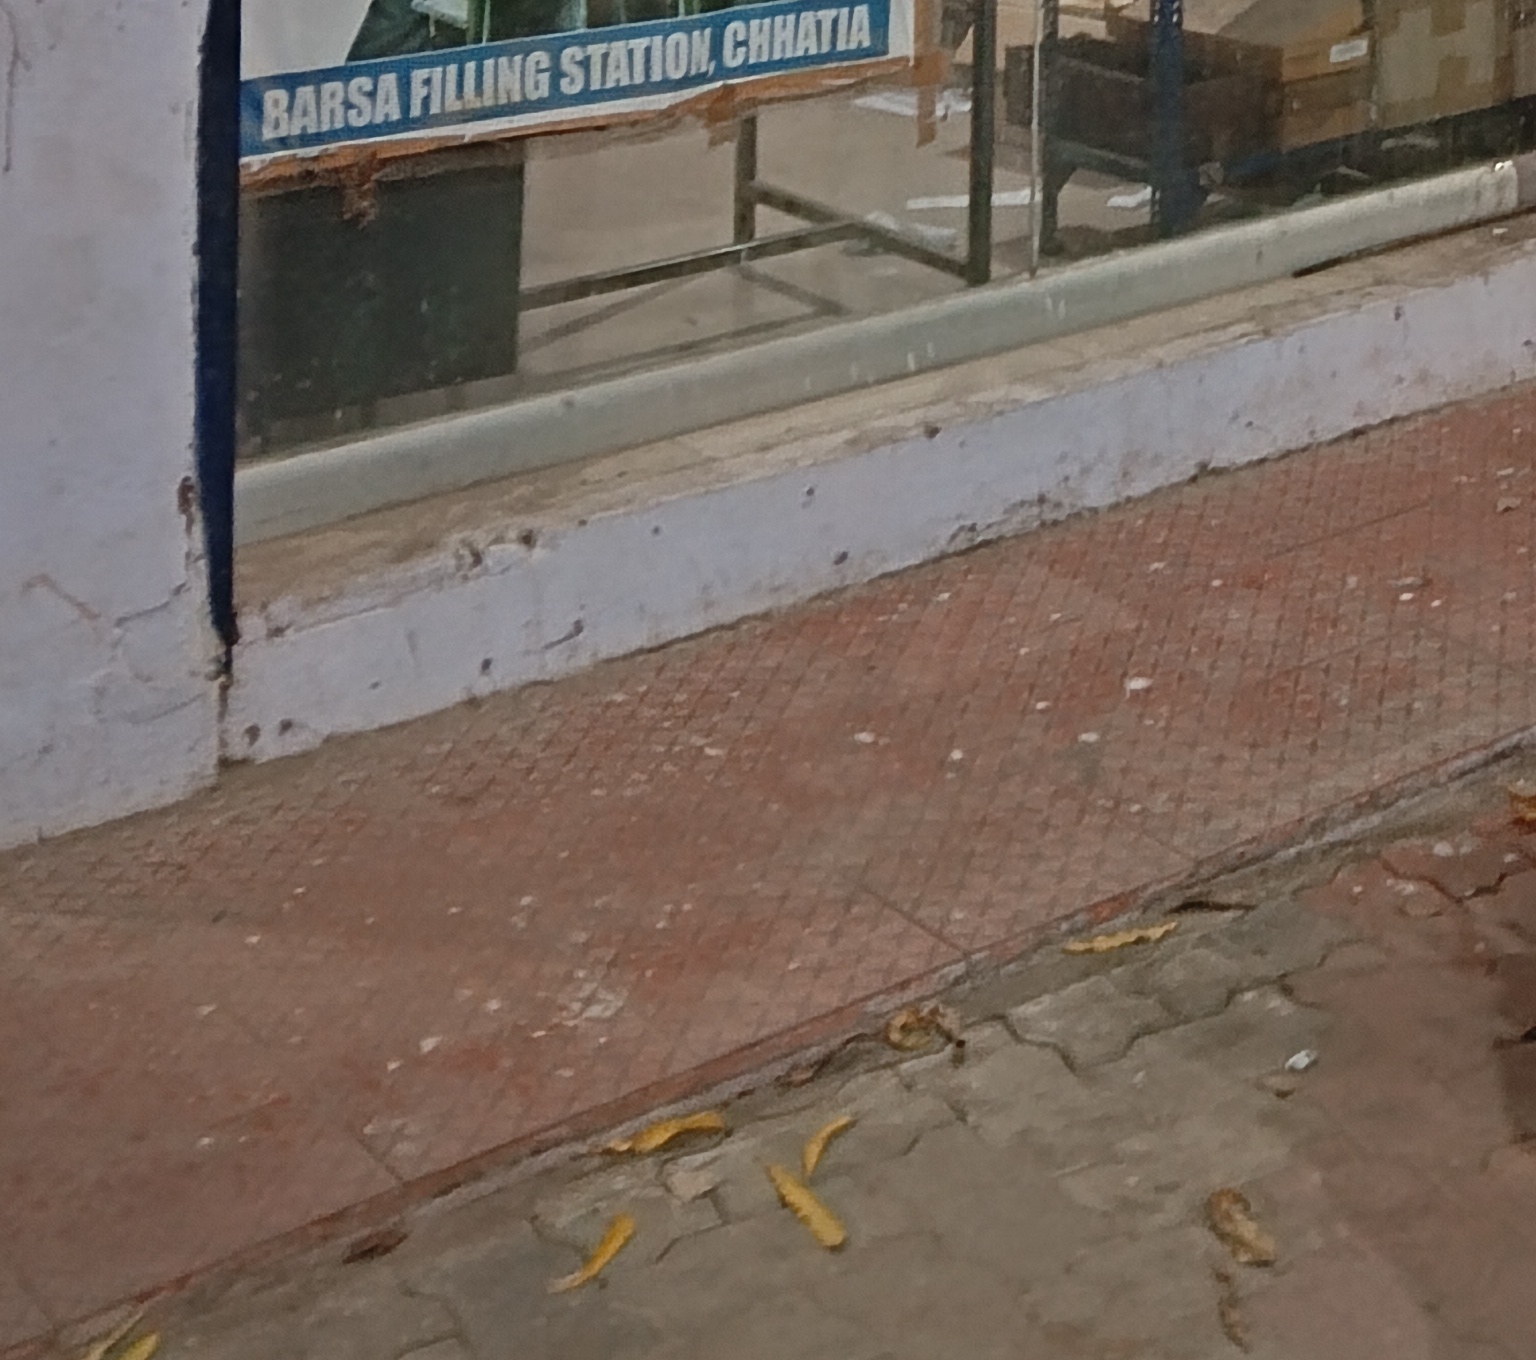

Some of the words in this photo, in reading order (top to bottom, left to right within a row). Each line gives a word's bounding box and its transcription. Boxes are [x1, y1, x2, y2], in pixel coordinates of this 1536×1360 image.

[262, 71, 401, 142] BARSA
[408, 56, 552, 117] FILLING
[558, 27, 715, 93] STATION,
[722, 3, 871, 64] CHHATIA
